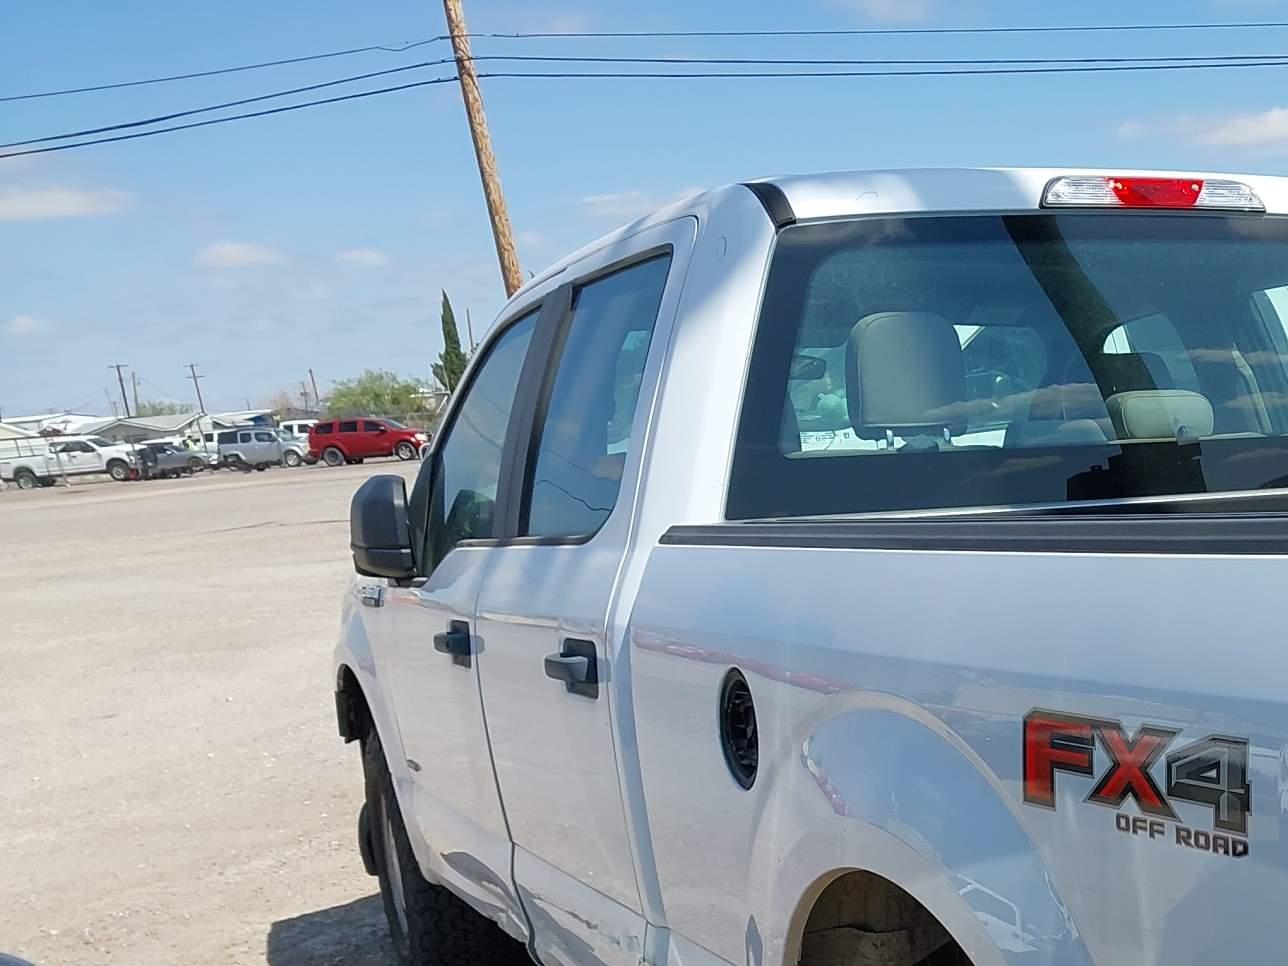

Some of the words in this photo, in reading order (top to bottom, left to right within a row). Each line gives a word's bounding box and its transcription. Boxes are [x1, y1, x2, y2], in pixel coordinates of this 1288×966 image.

[1022, 707, 1252, 838] FX4
[1115, 812, 1166, 839] OFF
[1174, 824, 1250, 859] ROAD
